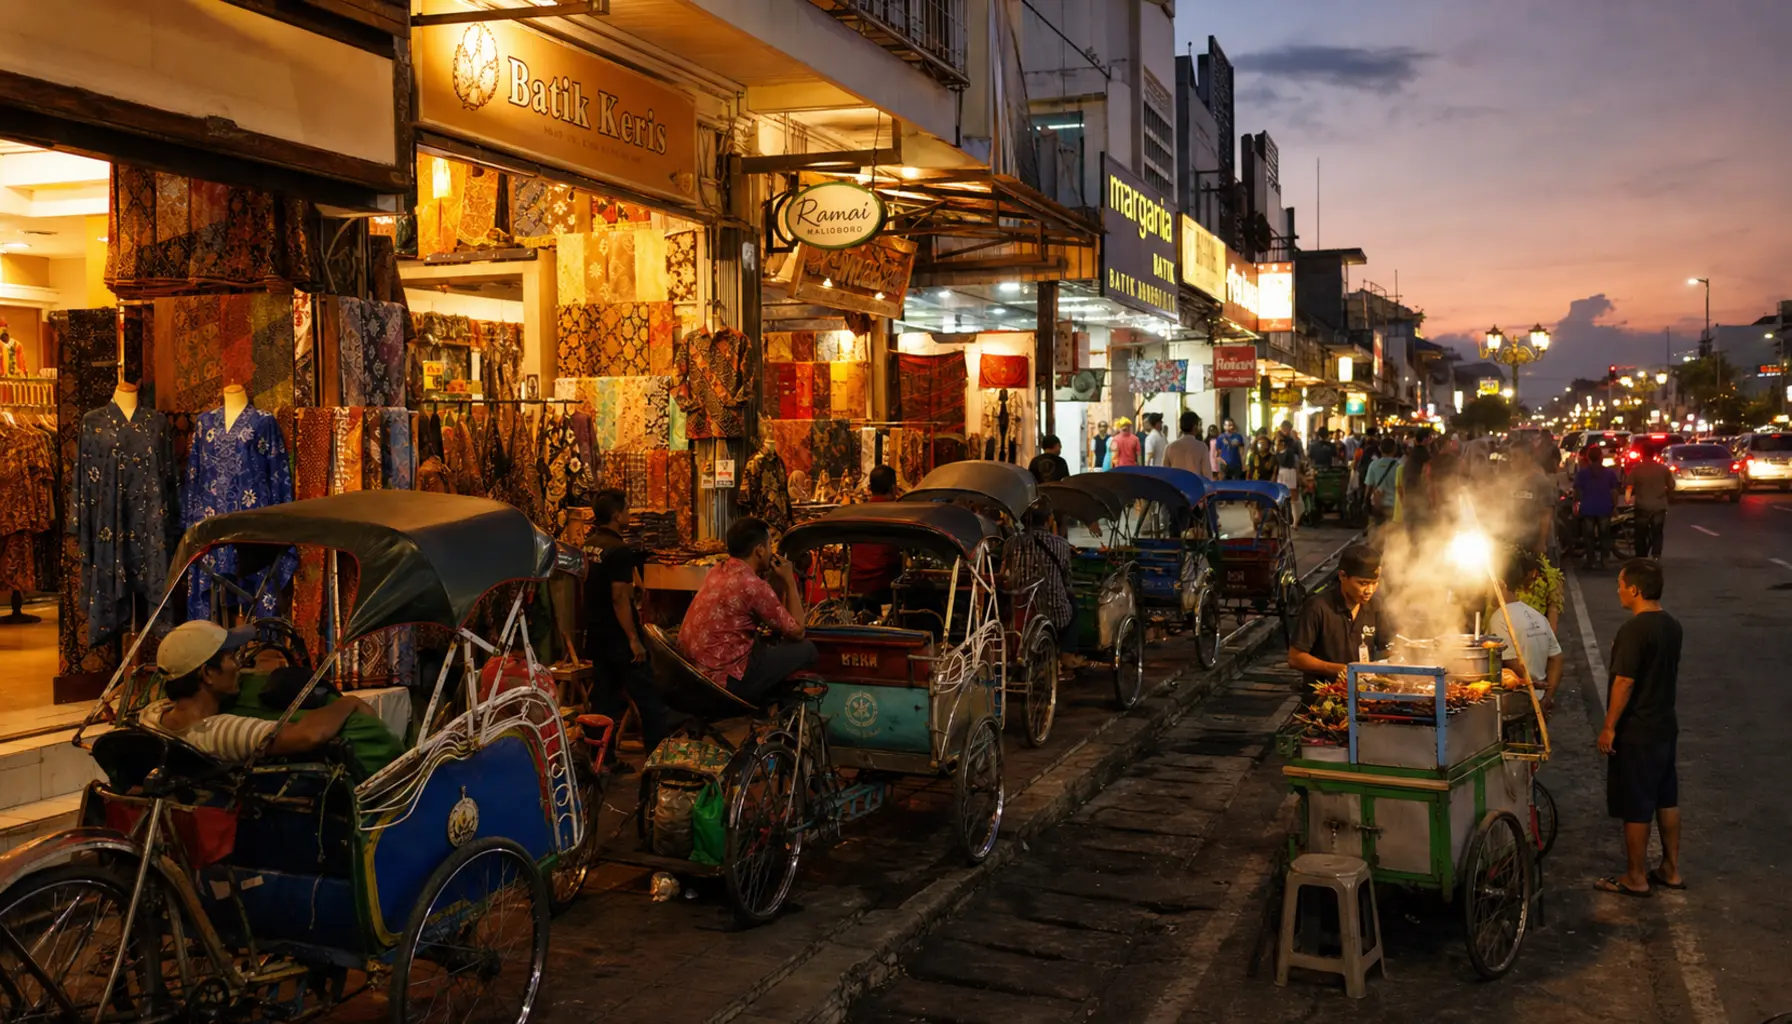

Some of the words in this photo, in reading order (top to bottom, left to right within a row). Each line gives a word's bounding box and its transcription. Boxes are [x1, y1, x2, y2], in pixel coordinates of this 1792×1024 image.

[507, 56, 592, 130] Batik
[598, 90, 667, 156] Keris
[796, 197, 872, 227] Ramai
[807, 226, 863, 236] MALIOBORO
[1109, 268, 1135, 297] BATIK
